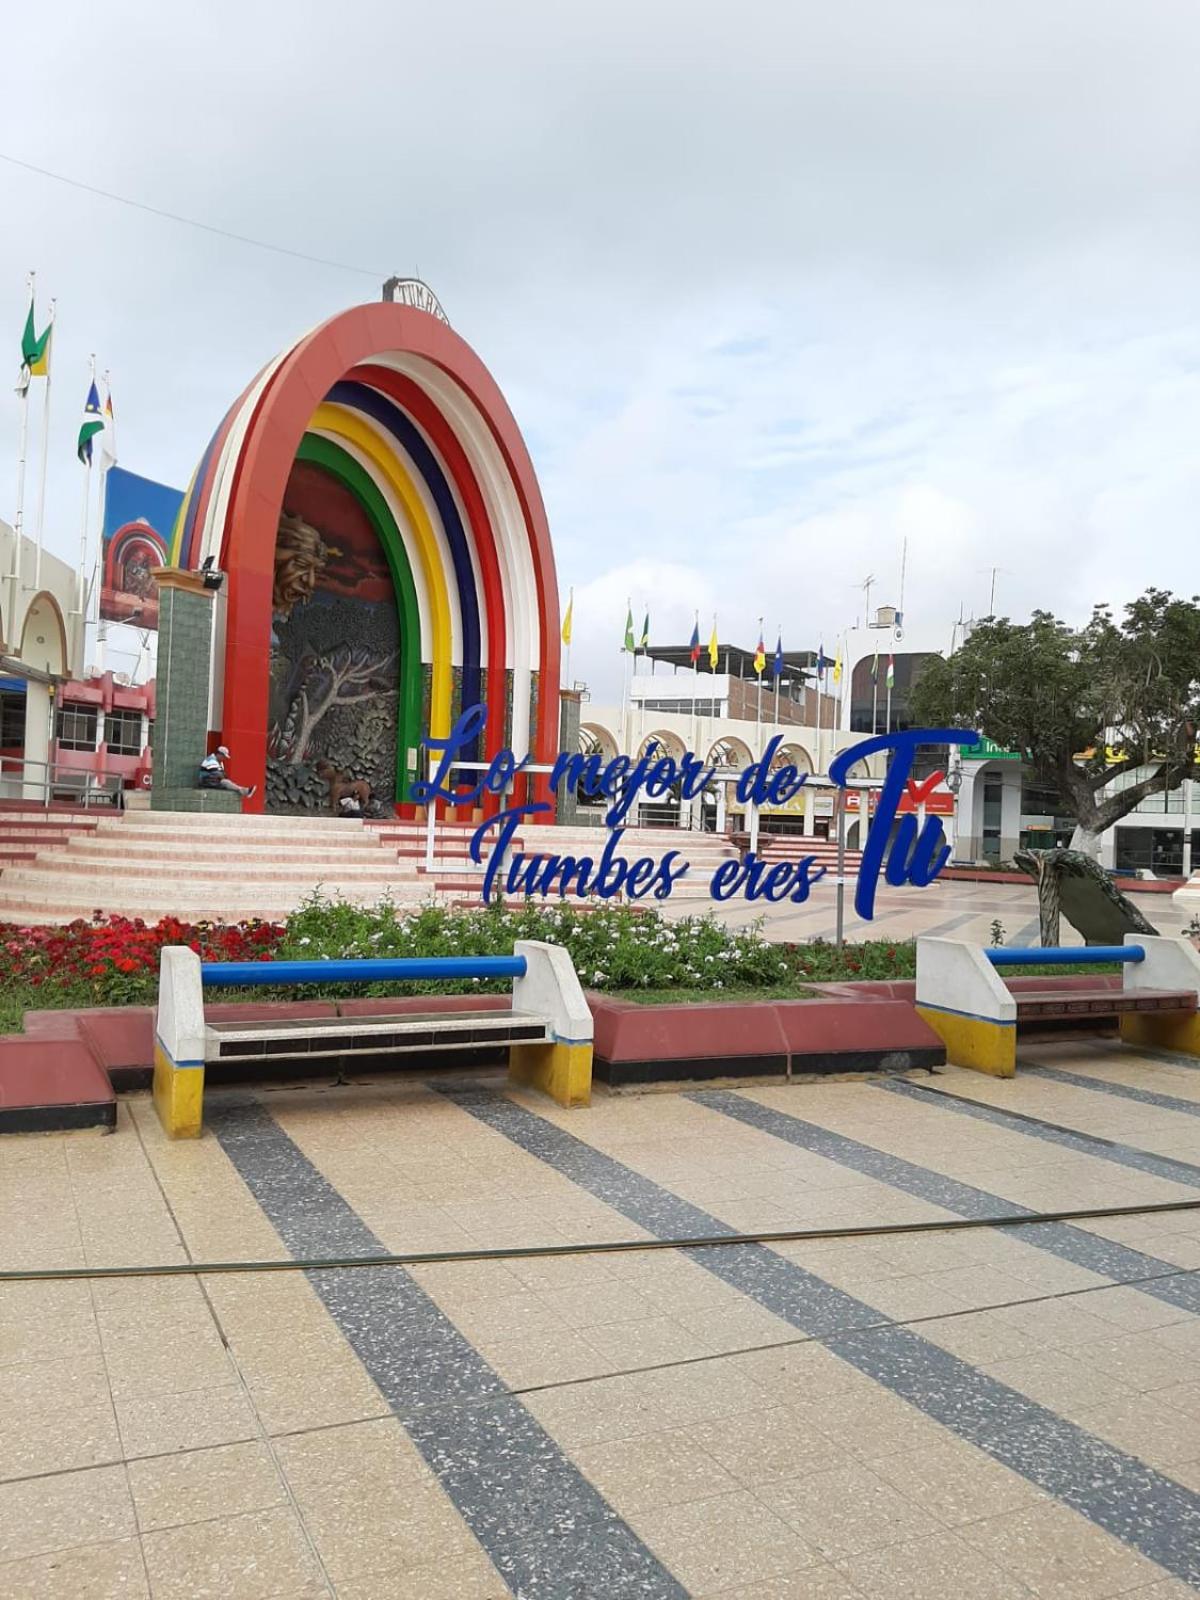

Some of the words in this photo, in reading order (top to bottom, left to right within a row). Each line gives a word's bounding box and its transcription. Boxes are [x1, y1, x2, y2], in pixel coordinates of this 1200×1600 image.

[409, 703, 529, 804] Lo
[549, 741, 716, 828] mejor
[735, 734, 809, 806] de
[468, 801, 690, 905] Tumbes
[709, 852, 827, 903] eres
